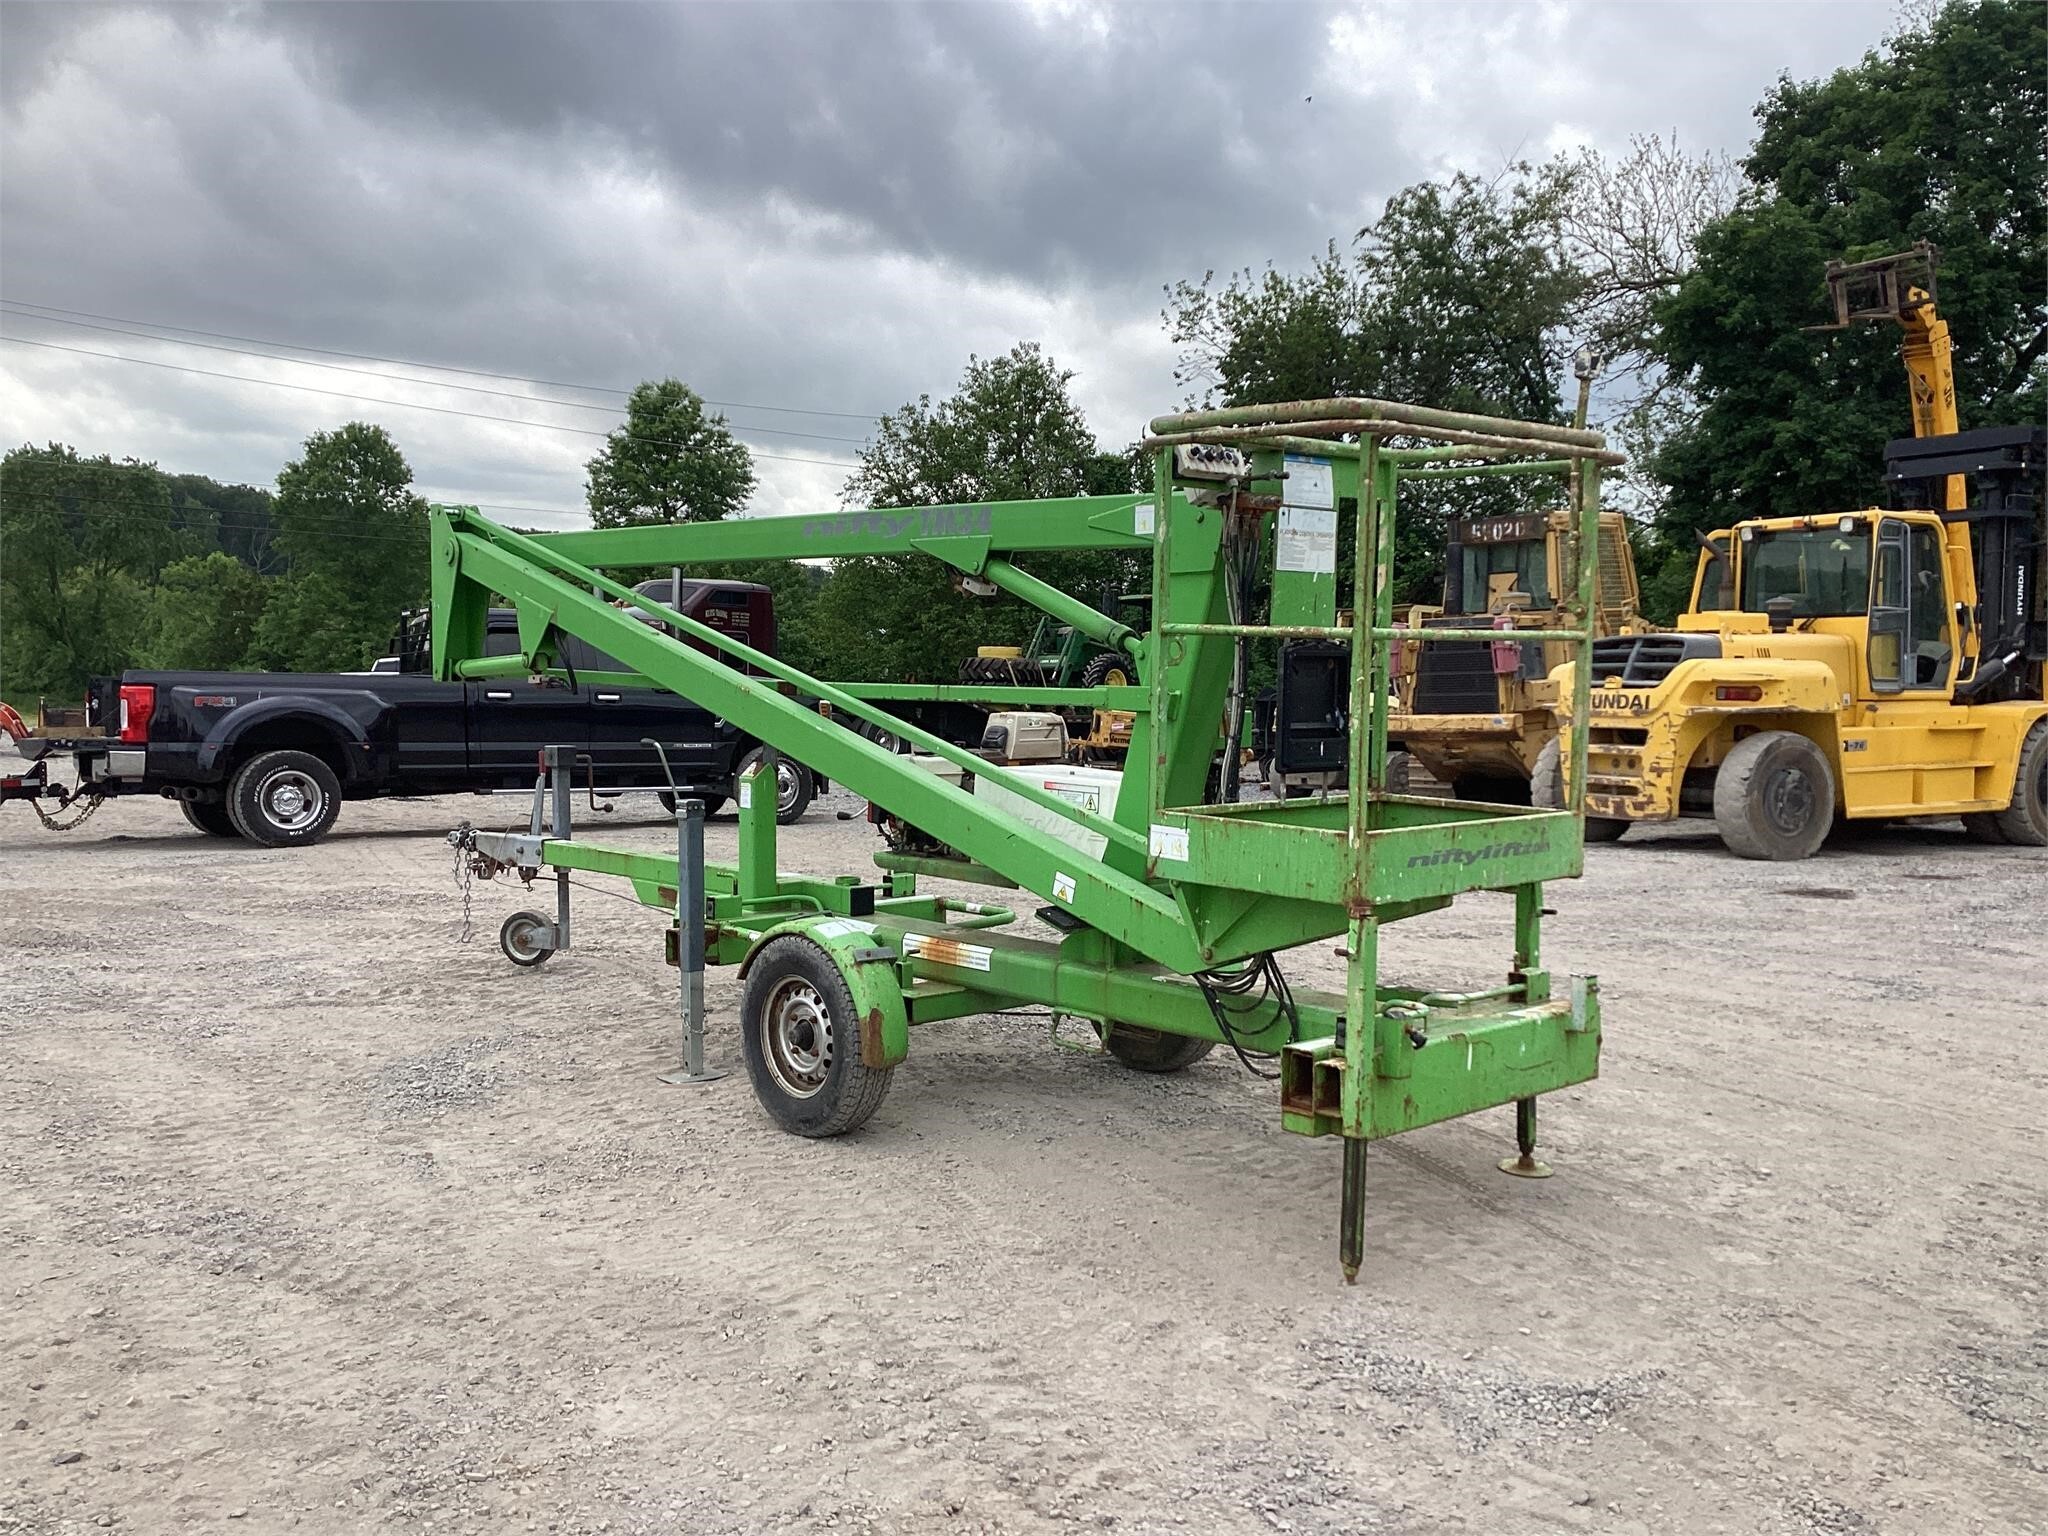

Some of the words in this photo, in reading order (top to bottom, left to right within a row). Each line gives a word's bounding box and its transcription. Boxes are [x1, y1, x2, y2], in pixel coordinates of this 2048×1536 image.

[2017, 565, 2025, 615] HYUNDAI
[194, 696, 237, 707] FX4
[1590, 694, 1651, 710] UNDAI
